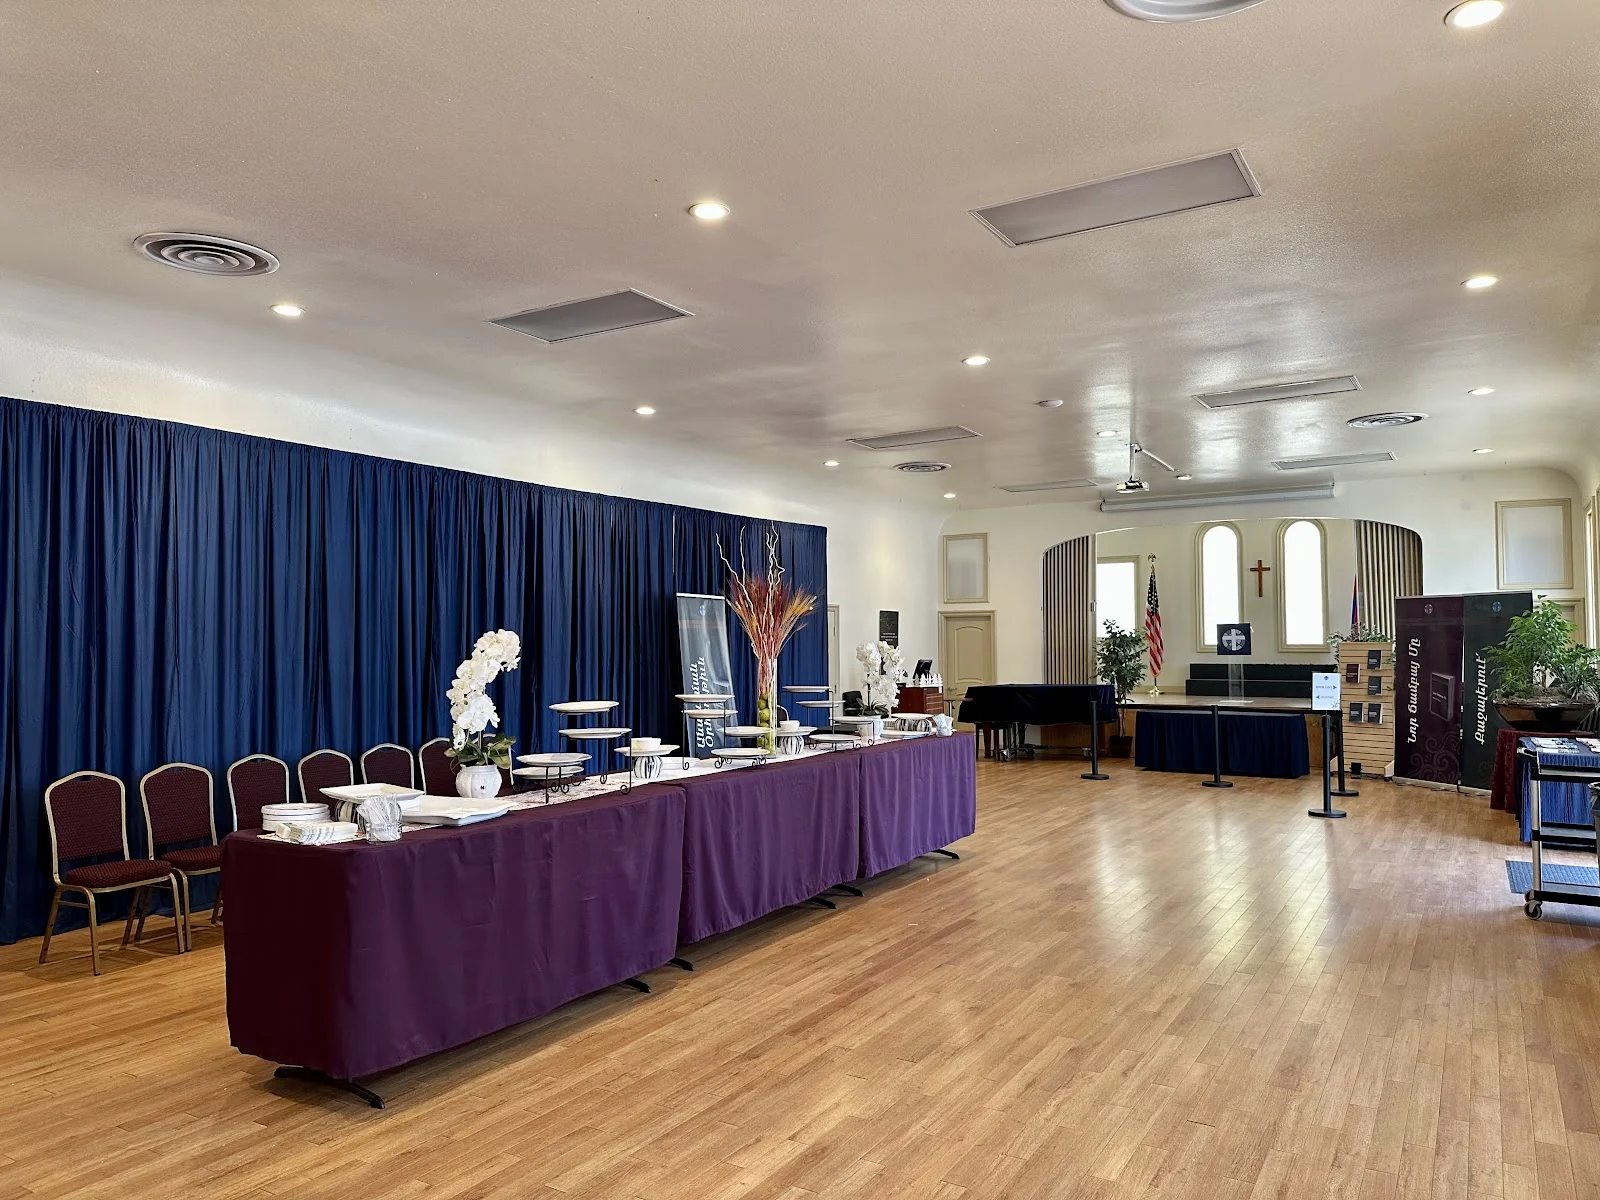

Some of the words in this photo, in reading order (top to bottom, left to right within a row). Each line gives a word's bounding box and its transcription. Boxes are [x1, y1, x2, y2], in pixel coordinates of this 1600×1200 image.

[1408, 638, 1421, 657] Մը
[1407, 660, 1420, 714] Ճամբայ
[1407, 717, 1419, 744] Նոր
